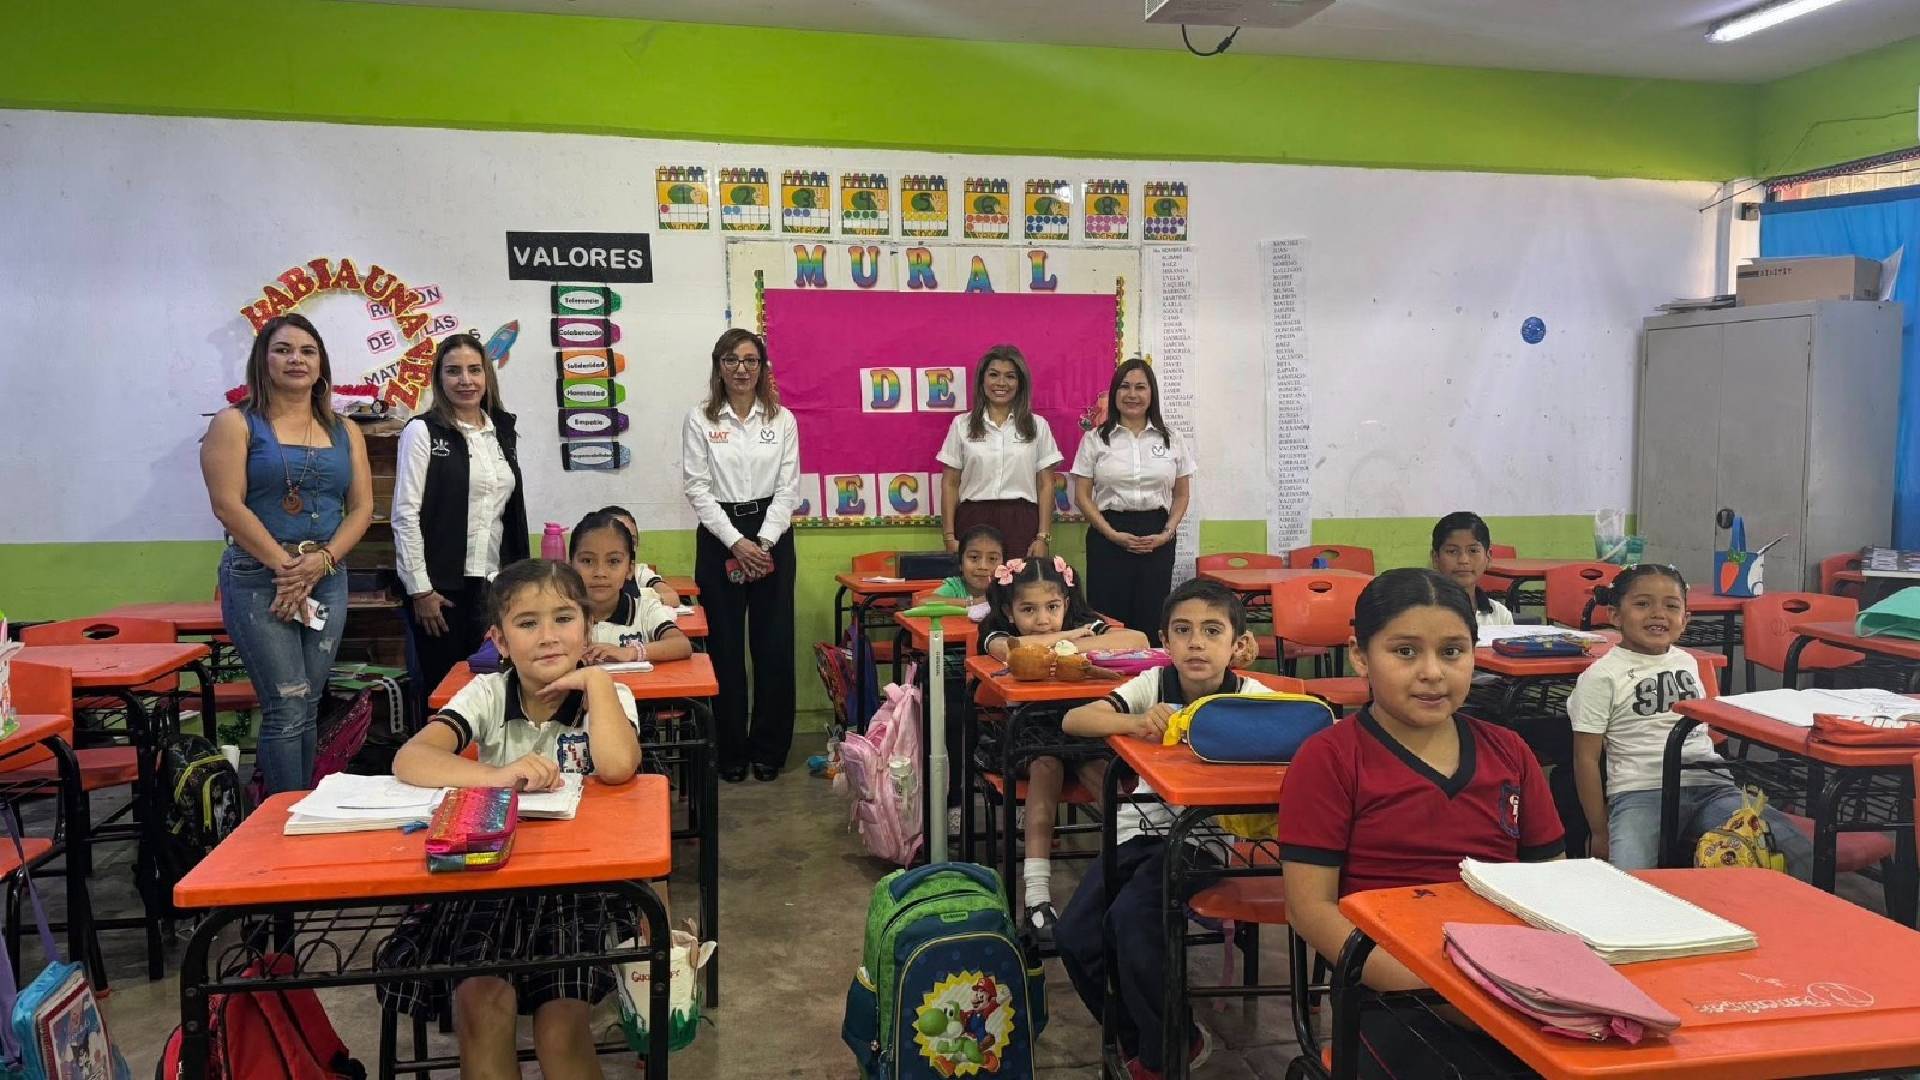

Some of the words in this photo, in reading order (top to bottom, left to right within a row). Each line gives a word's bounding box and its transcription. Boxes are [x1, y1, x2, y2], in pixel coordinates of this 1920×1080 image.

[514, 246, 643, 269] VALORES
[794, 245, 1057, 293] MURAL
[241, 258, 361, 338] HABIA
[363, 265, 429, 340] UNA
[368, 331, 393, 350] DE
[424, 315, 456, 335] LAS
[384, 337, 436, 411] VEZ
[870, 368, 956, 409] DE
[709, 431, 730, 439] UAT
[1633, 670, 1700, 716] SAS
